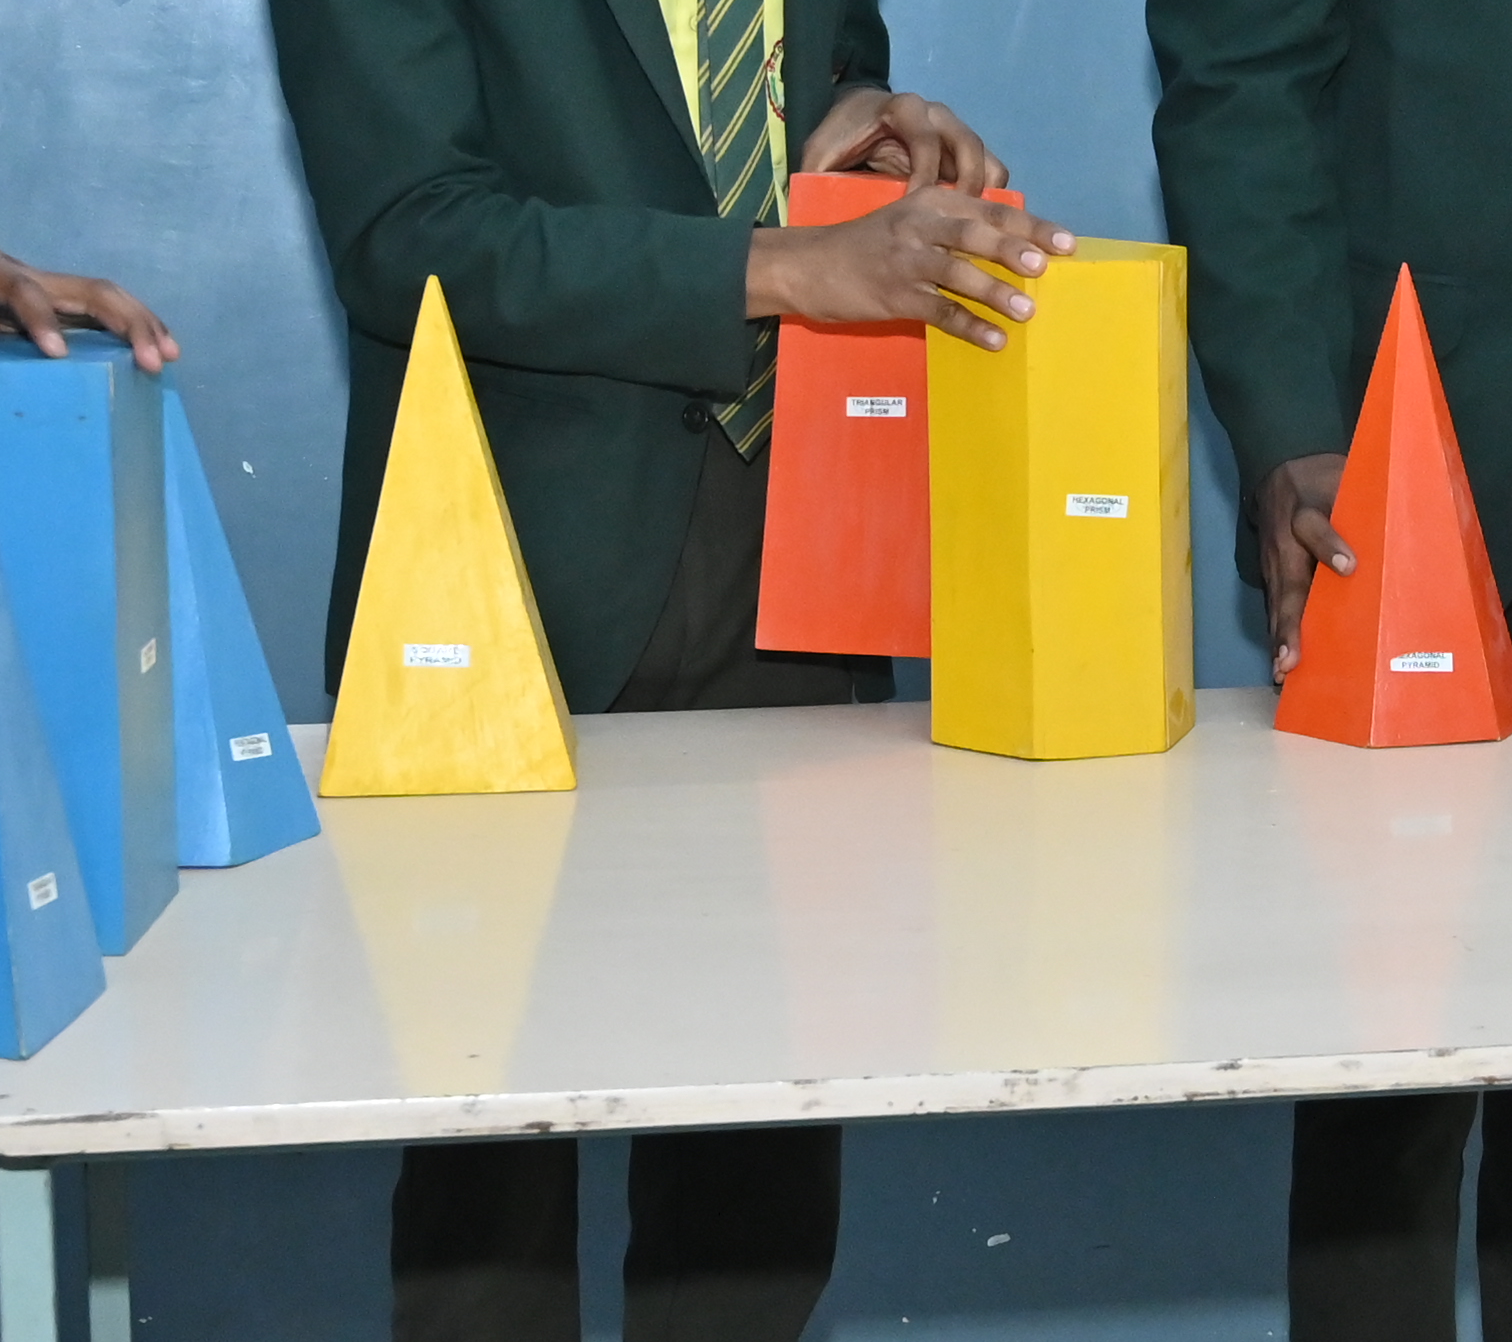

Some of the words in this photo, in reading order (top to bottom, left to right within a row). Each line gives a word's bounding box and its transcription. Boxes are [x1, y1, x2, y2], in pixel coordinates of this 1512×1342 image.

[1072, 497, 1125, 505] HEXAGONAL
[1084, 506, 1111, 514] PRISM
[1401, 661, 1440, 669] PYRAMID
